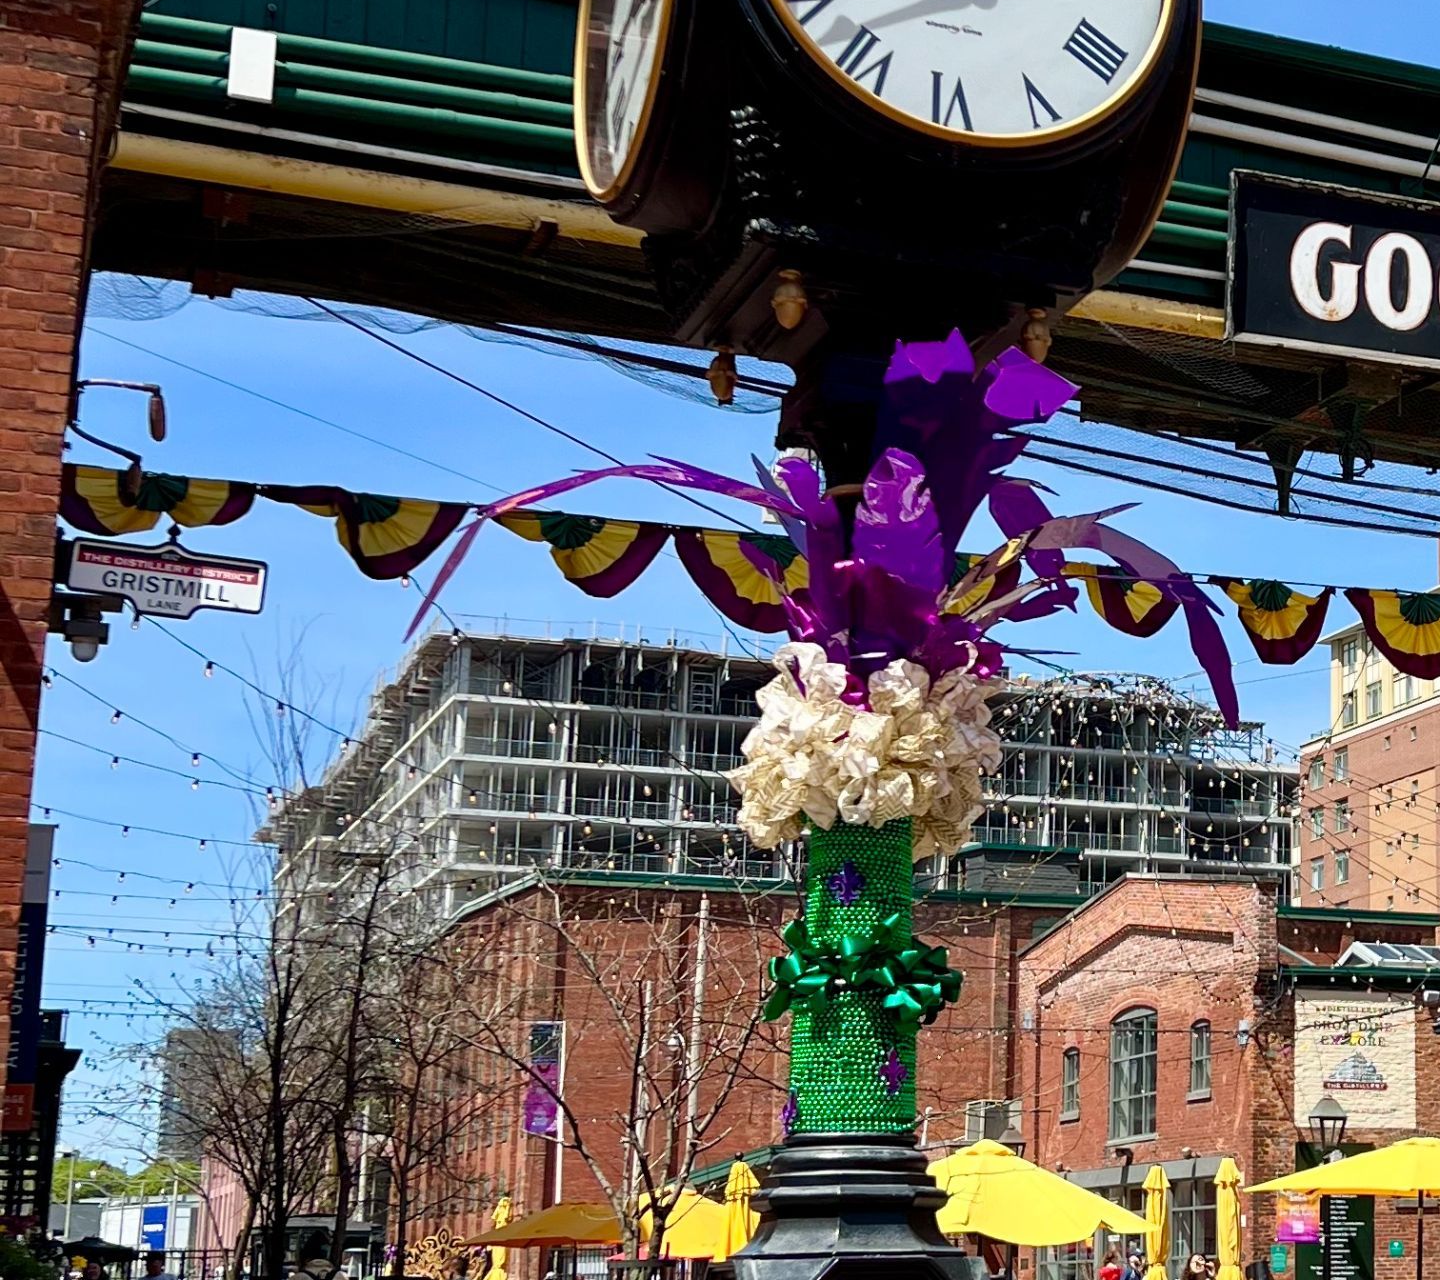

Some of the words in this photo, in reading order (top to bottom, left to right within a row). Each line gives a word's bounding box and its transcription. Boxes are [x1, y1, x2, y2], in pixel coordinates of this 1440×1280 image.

[83, 551, 112, 565] THE
[114, 556, 194, 576] DISTILLERY
[193, 567, 255, 583] DISTRICT
[102, 570, 230, 603] GRISTMILL
[147, 598, 181, 612] LANE
